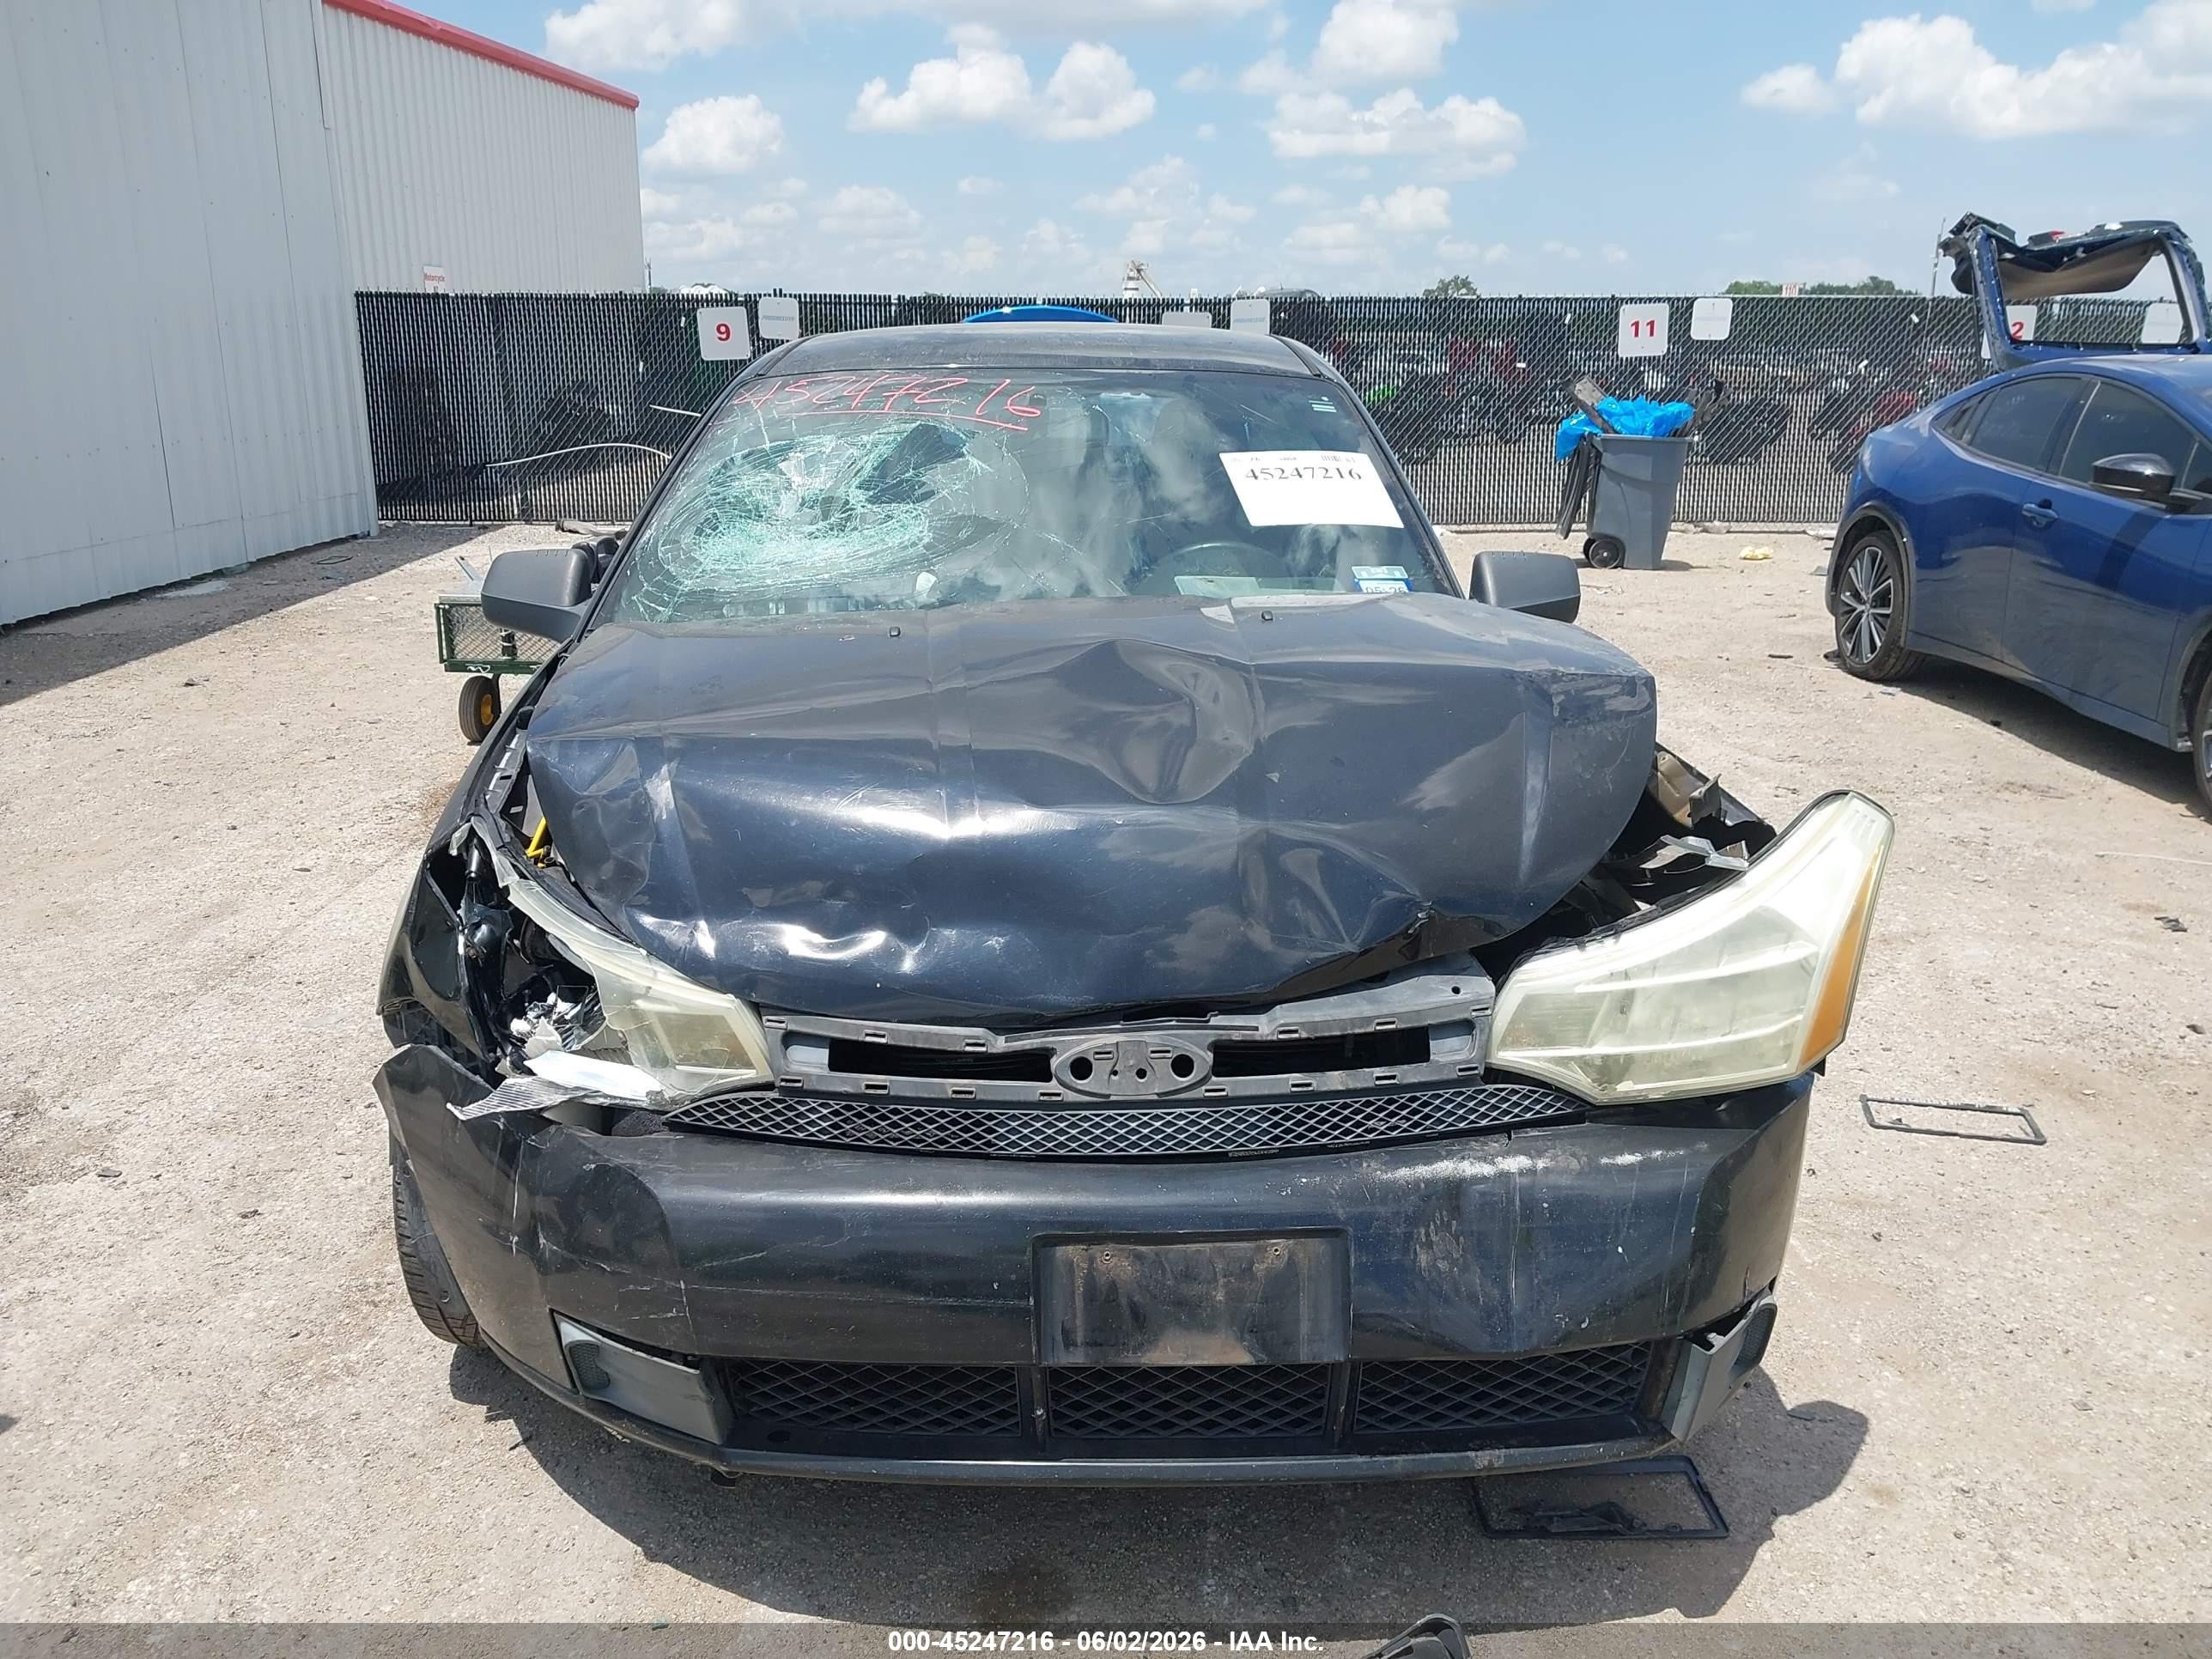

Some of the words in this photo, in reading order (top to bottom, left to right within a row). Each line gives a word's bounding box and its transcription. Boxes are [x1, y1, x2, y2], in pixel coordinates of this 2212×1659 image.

[715, 323, 732, 342] 9
[1630, 319, 1656, 337] 11
[2011, 321, 2024, 339] 2
[1245, 466, 1363, 481] 45247216
